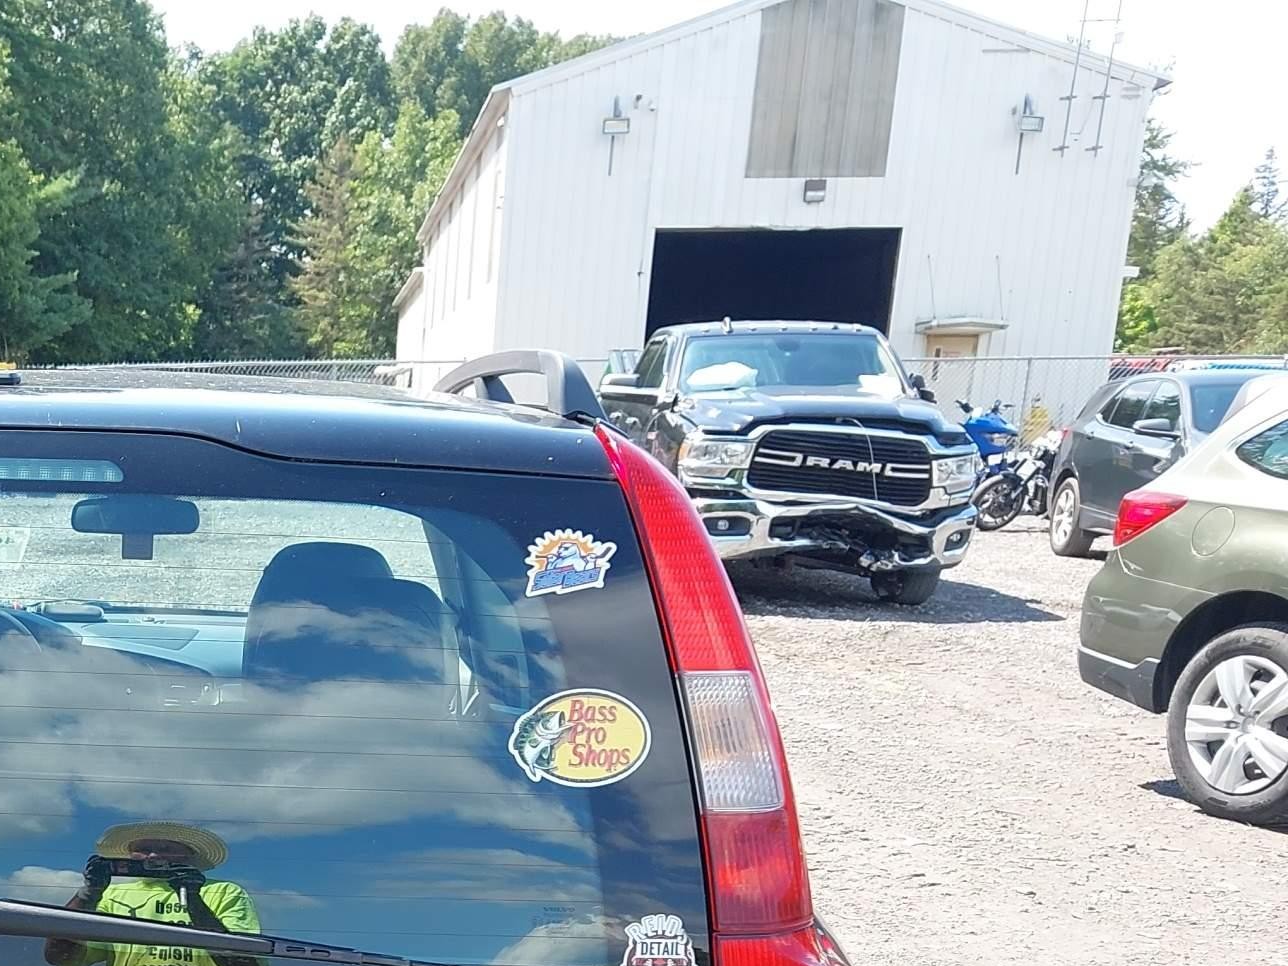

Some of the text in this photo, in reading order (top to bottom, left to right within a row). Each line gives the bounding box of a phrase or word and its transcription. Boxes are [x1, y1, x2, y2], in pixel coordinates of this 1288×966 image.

[806, 455, 882, 473] RAM
[567, 699, 617, 723] Bass
[567, 721, 606, 744] Pro
[567, 743, 631, 771] Shops
[640, 941, 682, 956] DETAIL
